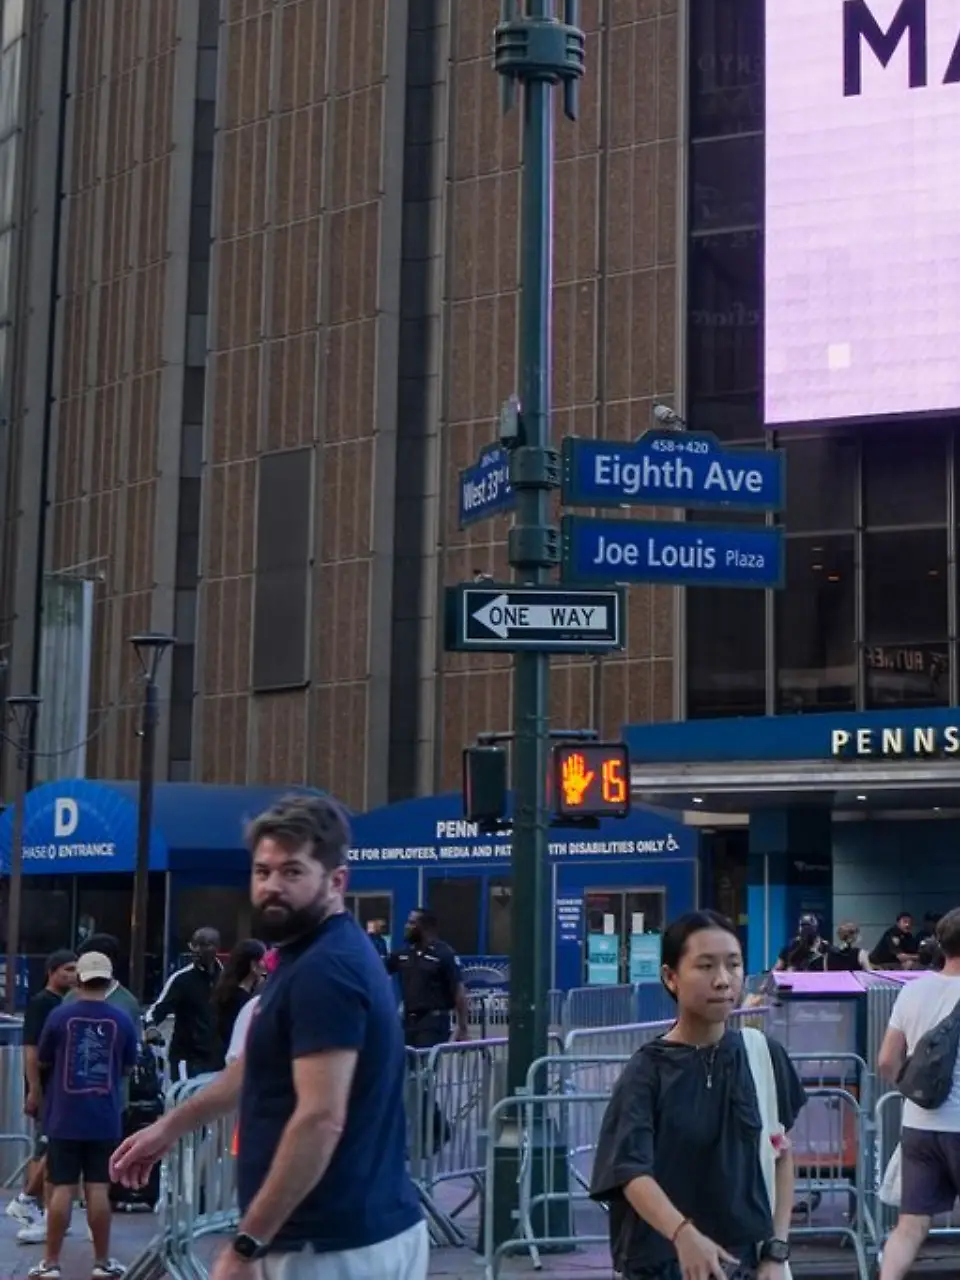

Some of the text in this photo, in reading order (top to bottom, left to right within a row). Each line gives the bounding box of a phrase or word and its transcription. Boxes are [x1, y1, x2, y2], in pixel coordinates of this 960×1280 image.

[594, 454, 763, 494] Eighth Ave
[463, 478, 485, 511] West
[593, 535, 765, 568] Joe Louis Plaza
[489, 606, 595, 626] ONE WAY
[54, 797, 79, 837] D
[58, 842, 116, 858] ENTRANCE
[440, 845, 470, 858] MEDIA
[472, 845, 492, 857] AND
[549, 842, 567, 855] ITH
[568, 841, 635, 855] DISABILITIES
[636, 840, 666, 853] ONLY
